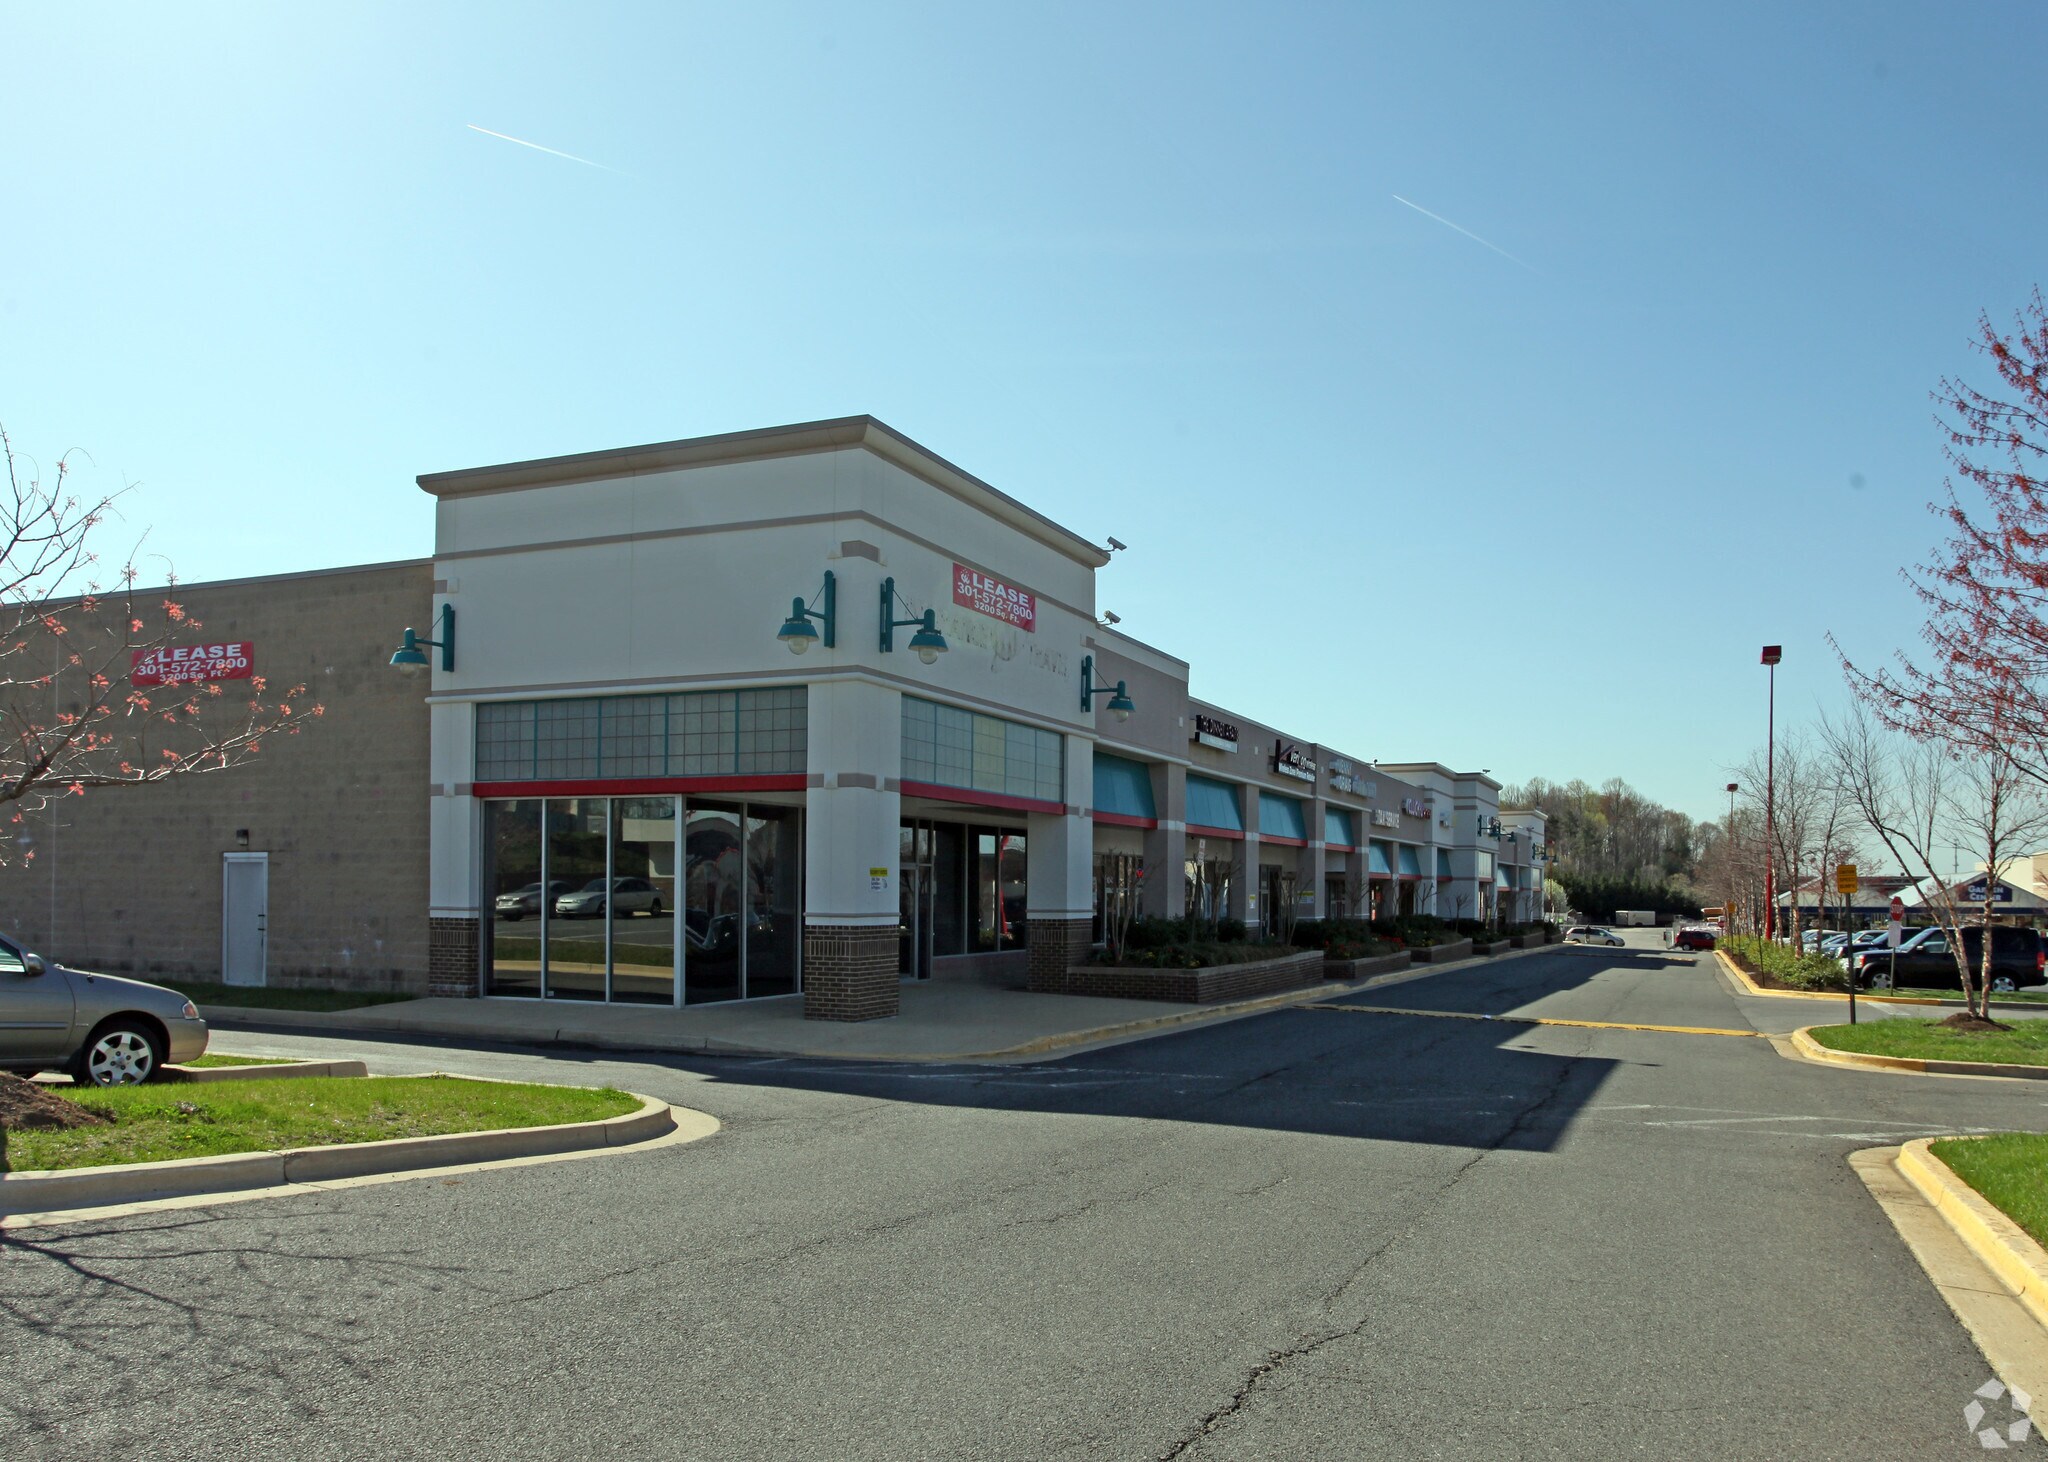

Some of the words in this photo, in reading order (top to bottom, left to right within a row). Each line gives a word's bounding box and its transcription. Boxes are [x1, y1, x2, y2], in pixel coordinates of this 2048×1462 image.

[973, 573, 1029, 608] LEASE
[957, 582, 1033, 620] 301-572-7800
[974, 600, 995, 615] 3200
[996, 608, 1008, 620] Sq.
[1009, 613, 1020, 624] Ft.
[157, 643, 242, 663] LEASE
[137, 657, 247, 676] 301-572-7800
[160, 672, 188, 682] 3200
[190, 671, 207, 680] Sq.
[1968, 885, 2004, 893] GAREN
[1891, 903, 1903, 914] STOP
